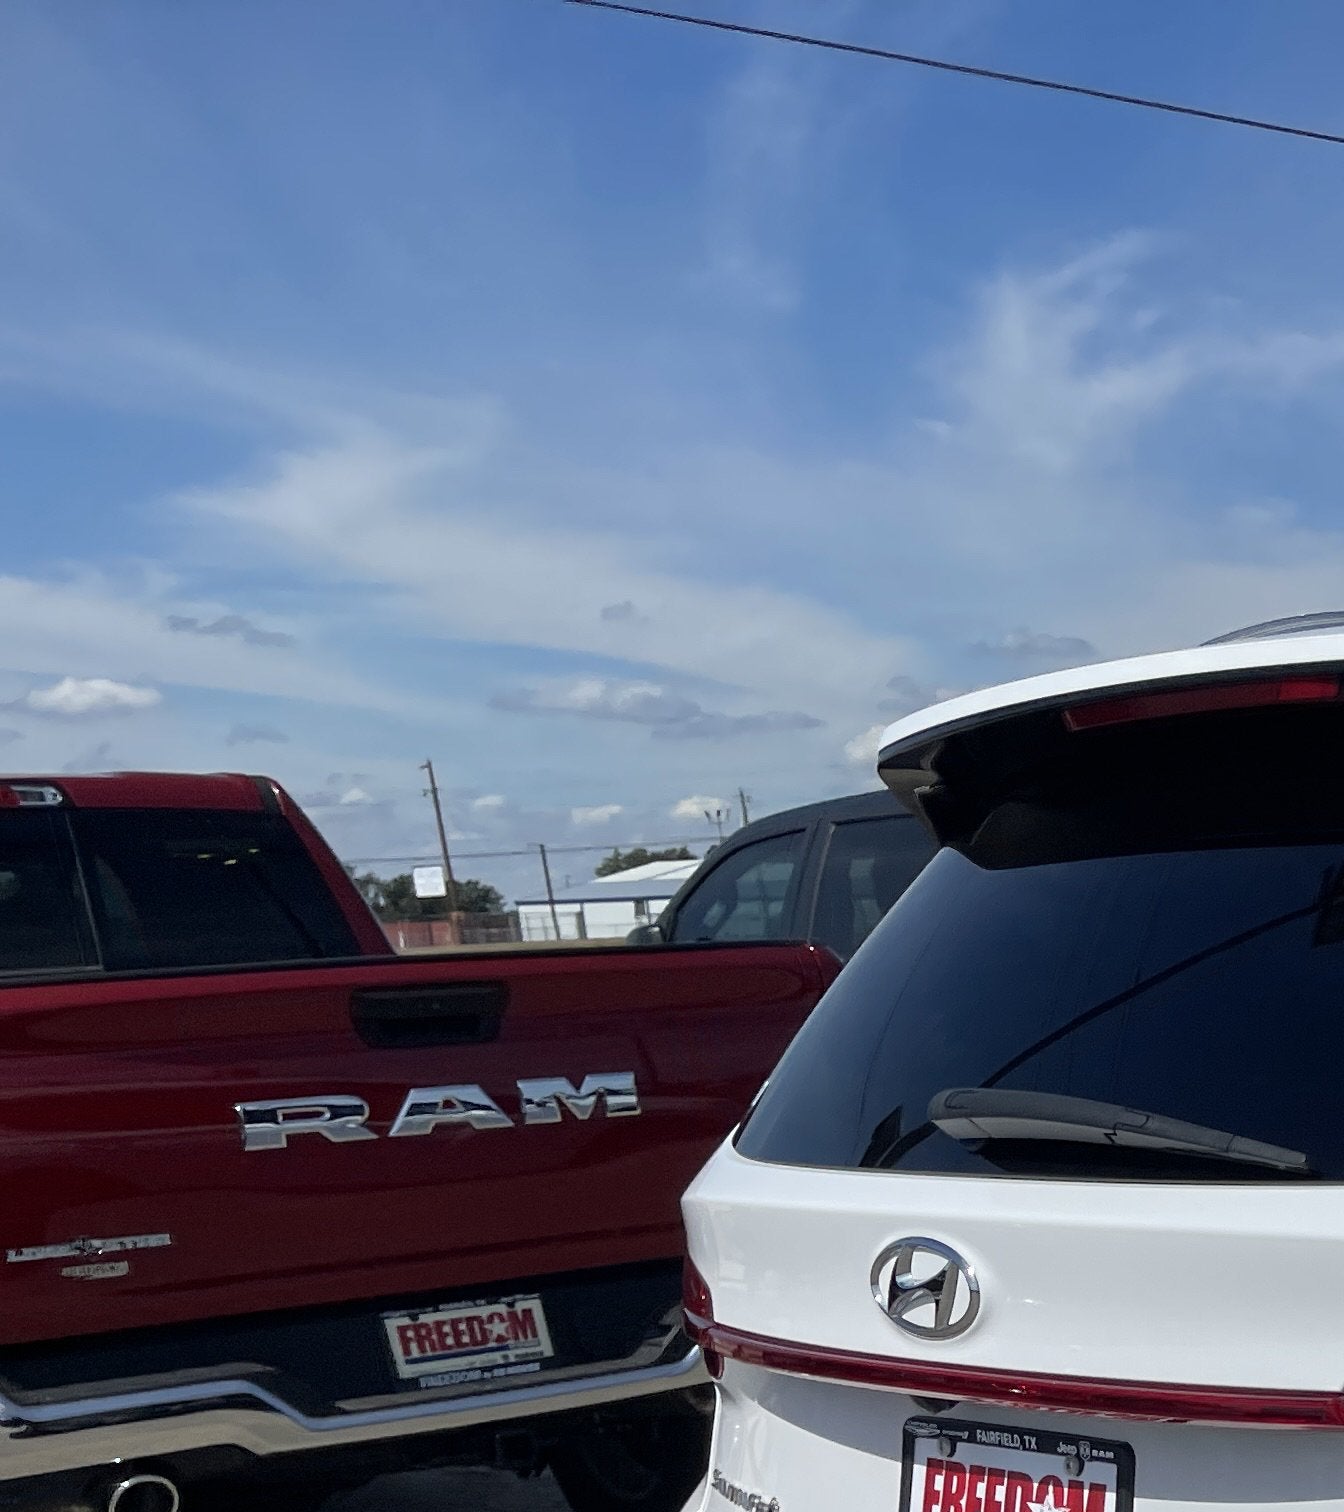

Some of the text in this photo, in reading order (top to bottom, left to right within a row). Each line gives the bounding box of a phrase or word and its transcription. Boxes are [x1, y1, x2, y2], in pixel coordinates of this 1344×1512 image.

[233, 1071, 641, 1151] RAM
[396, 1307, 539, 1357] FREEDOM
[976, 1429, 1023, 1450] FAIRFIELD,
[1023, 1435, 1037, 1450] TX
